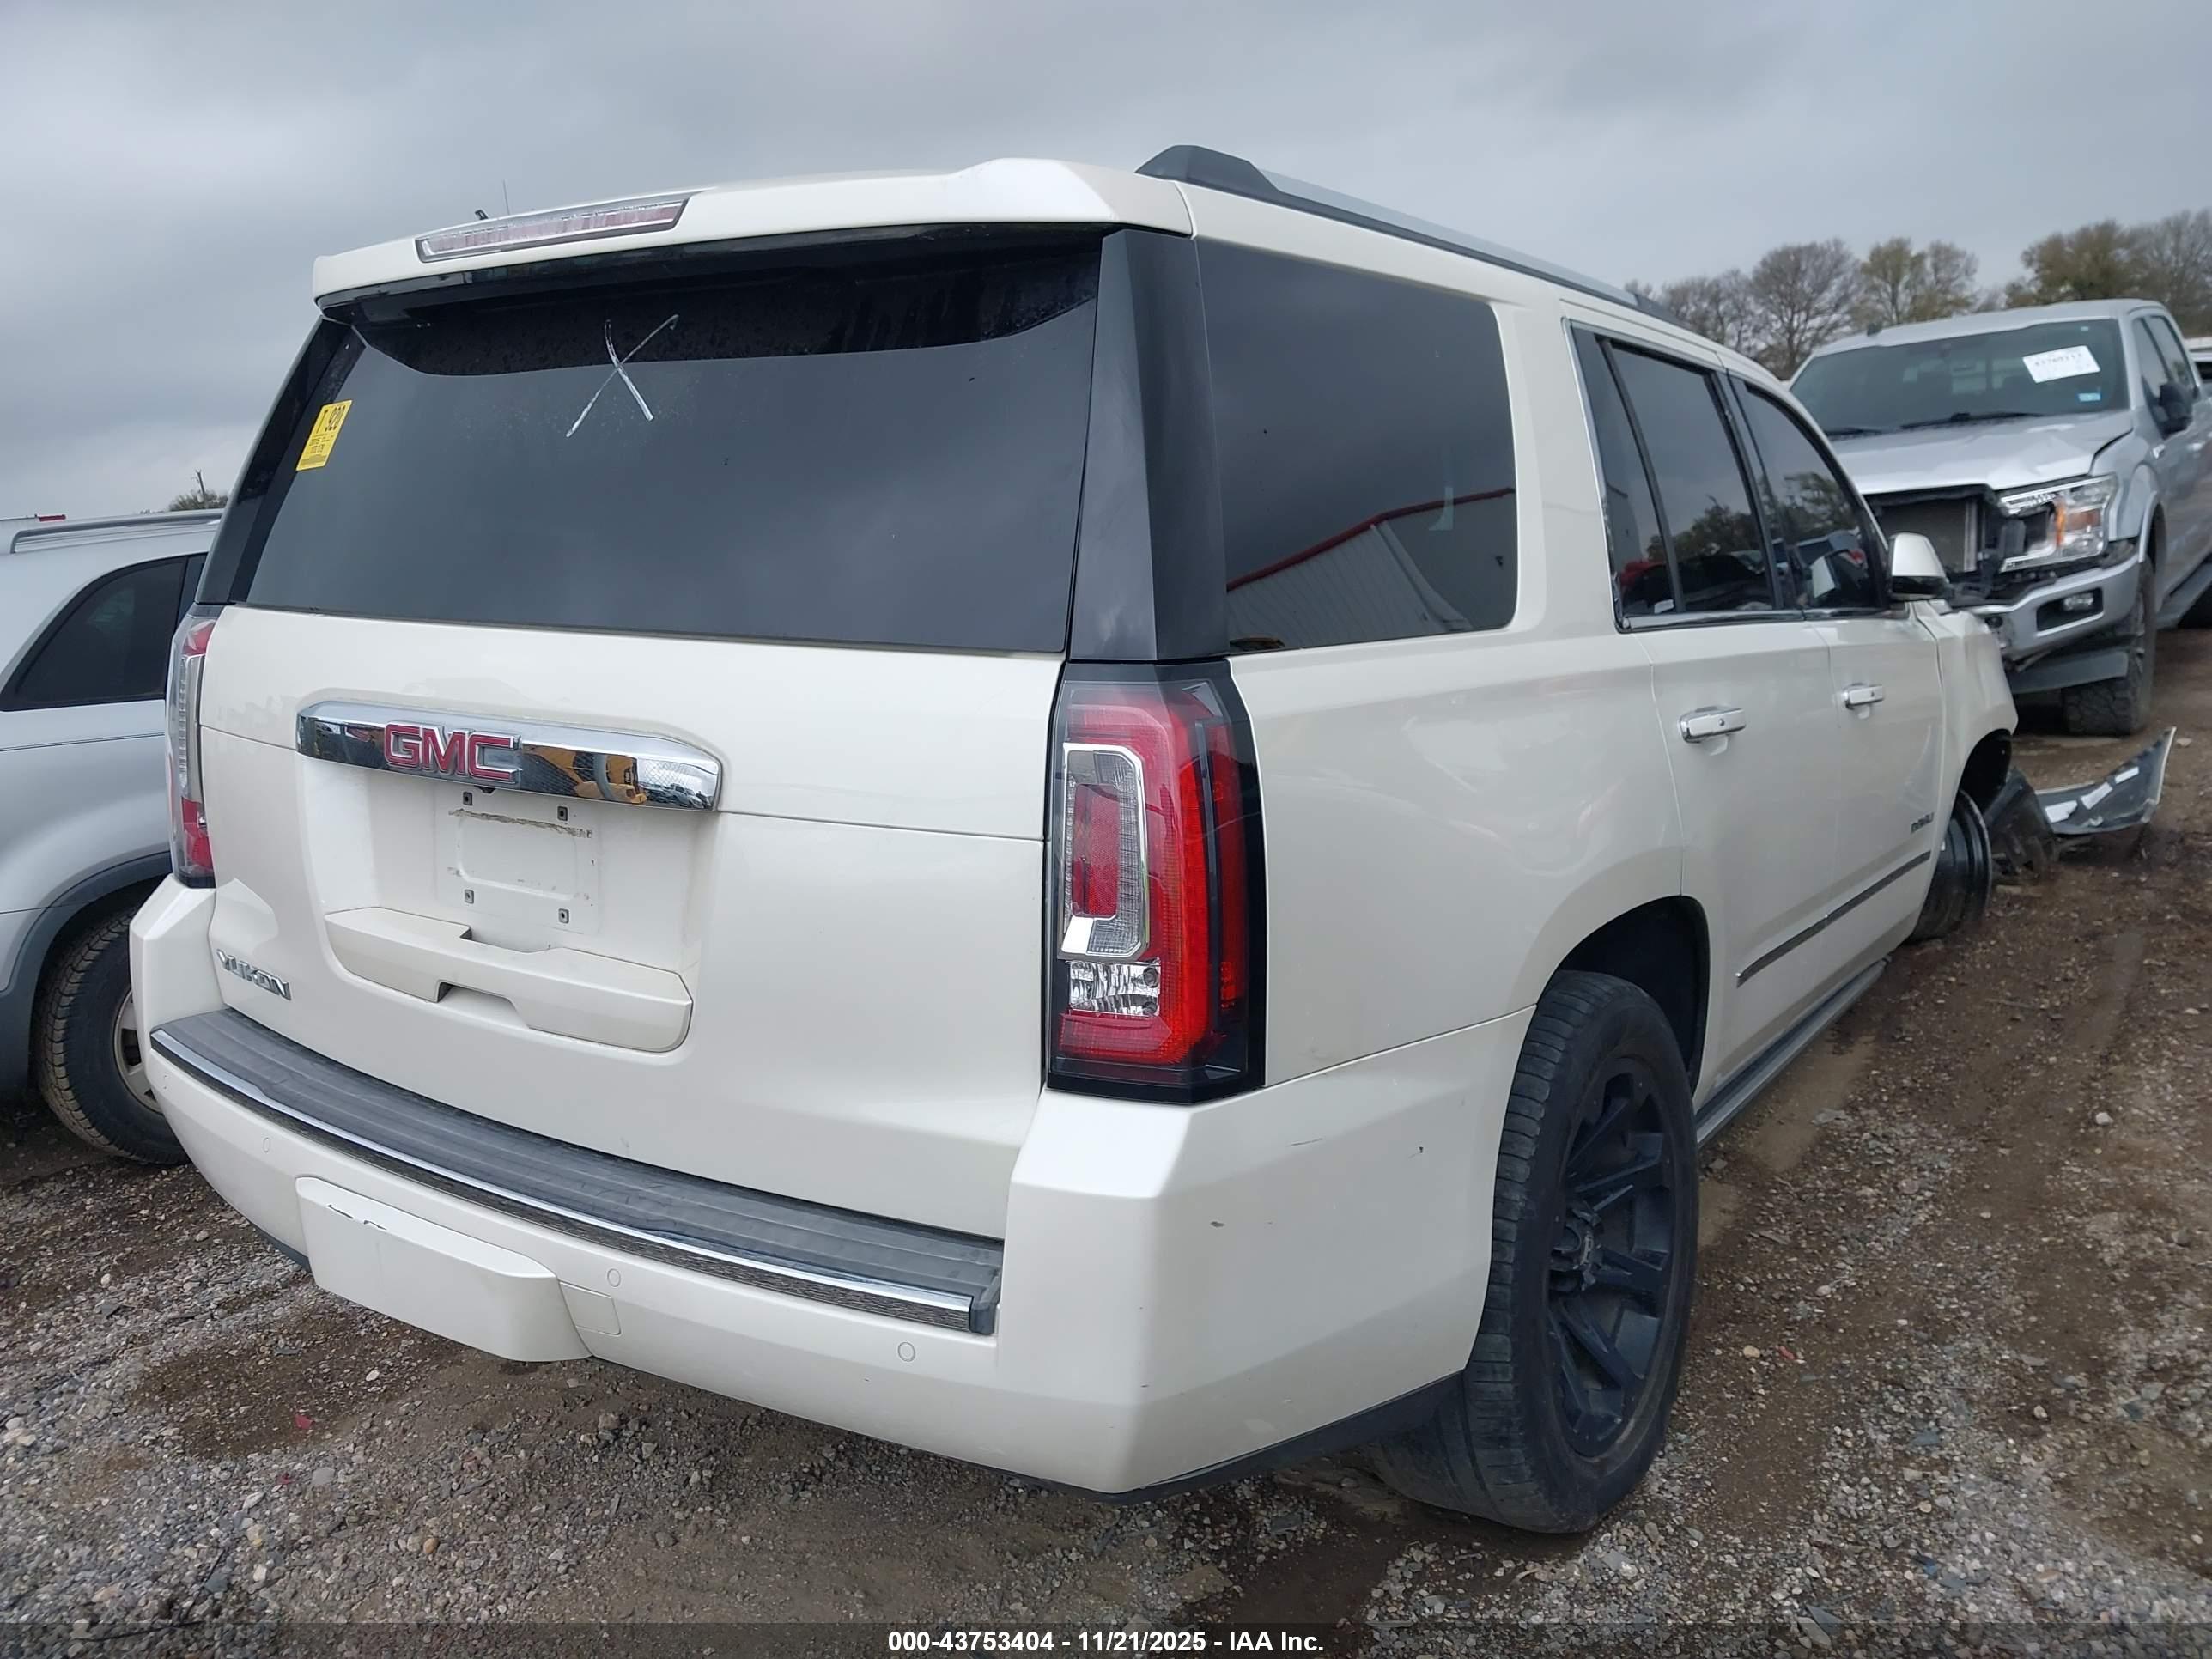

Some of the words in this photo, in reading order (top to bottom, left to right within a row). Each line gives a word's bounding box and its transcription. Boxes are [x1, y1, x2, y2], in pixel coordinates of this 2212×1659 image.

[316, 409, 329, 434] T
[385, 721, 522, 786] GMC
[216, 948, 292, 1001] YUKON
